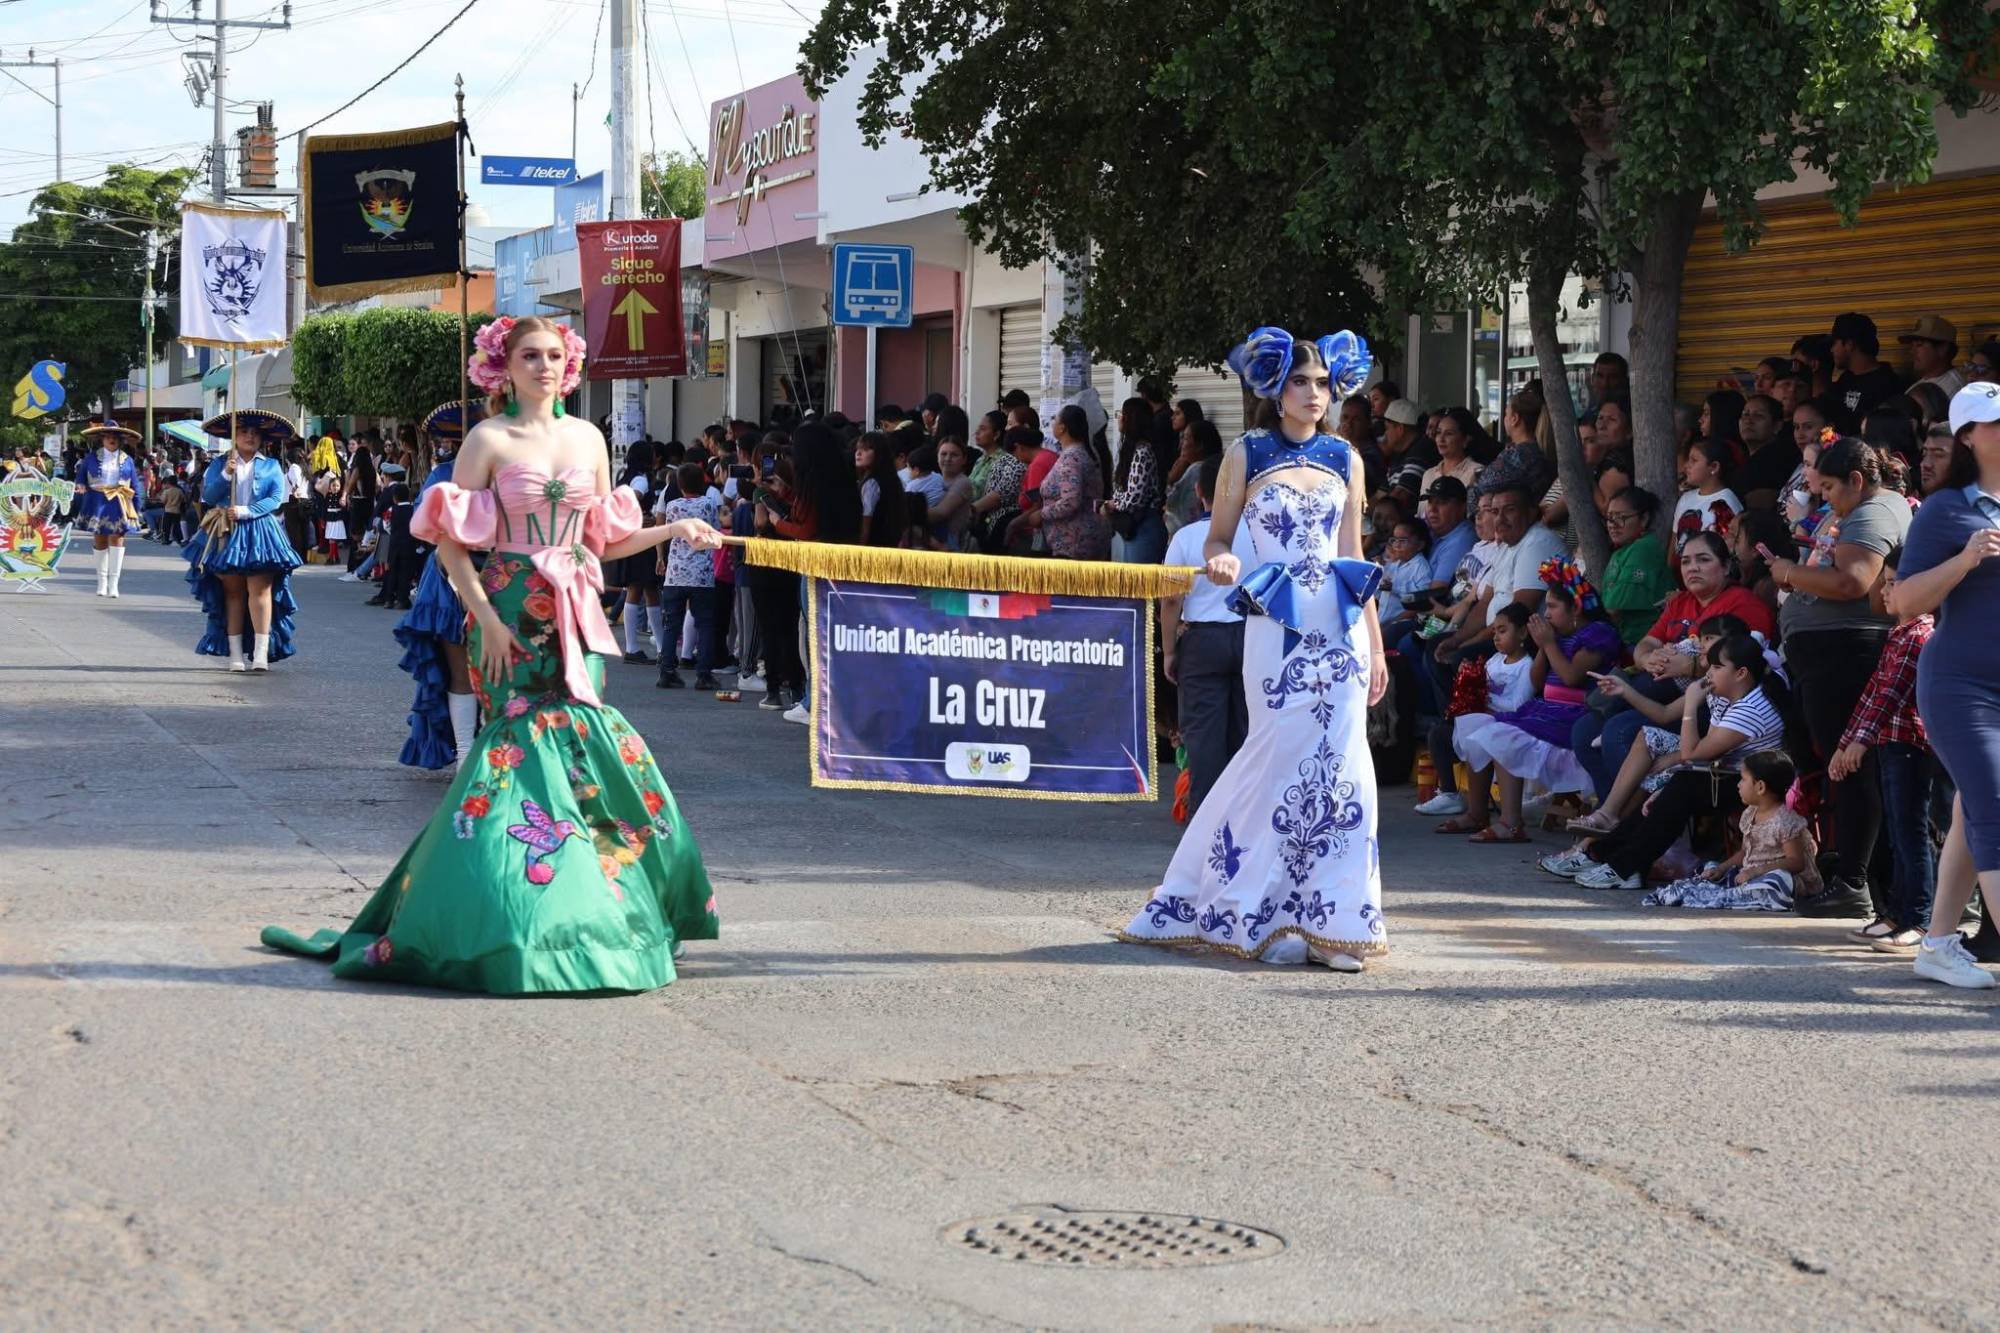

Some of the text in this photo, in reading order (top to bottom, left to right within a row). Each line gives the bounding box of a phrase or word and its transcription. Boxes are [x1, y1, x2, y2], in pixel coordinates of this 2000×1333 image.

[752, 112, 815, 168] BOUTIQUE
[533, 166, 571, 178] telcel
[603, 228, 657, 246] Kuroda
[611, 257, 654, 273] Sigue
[601, 271, 665, 285] derecho
[834, 624, 1124, 666] Unidad Académica Preparatoria
[929, 677, 1046, 728] La Cruz
[988, 751, 1011, 764] UAS
